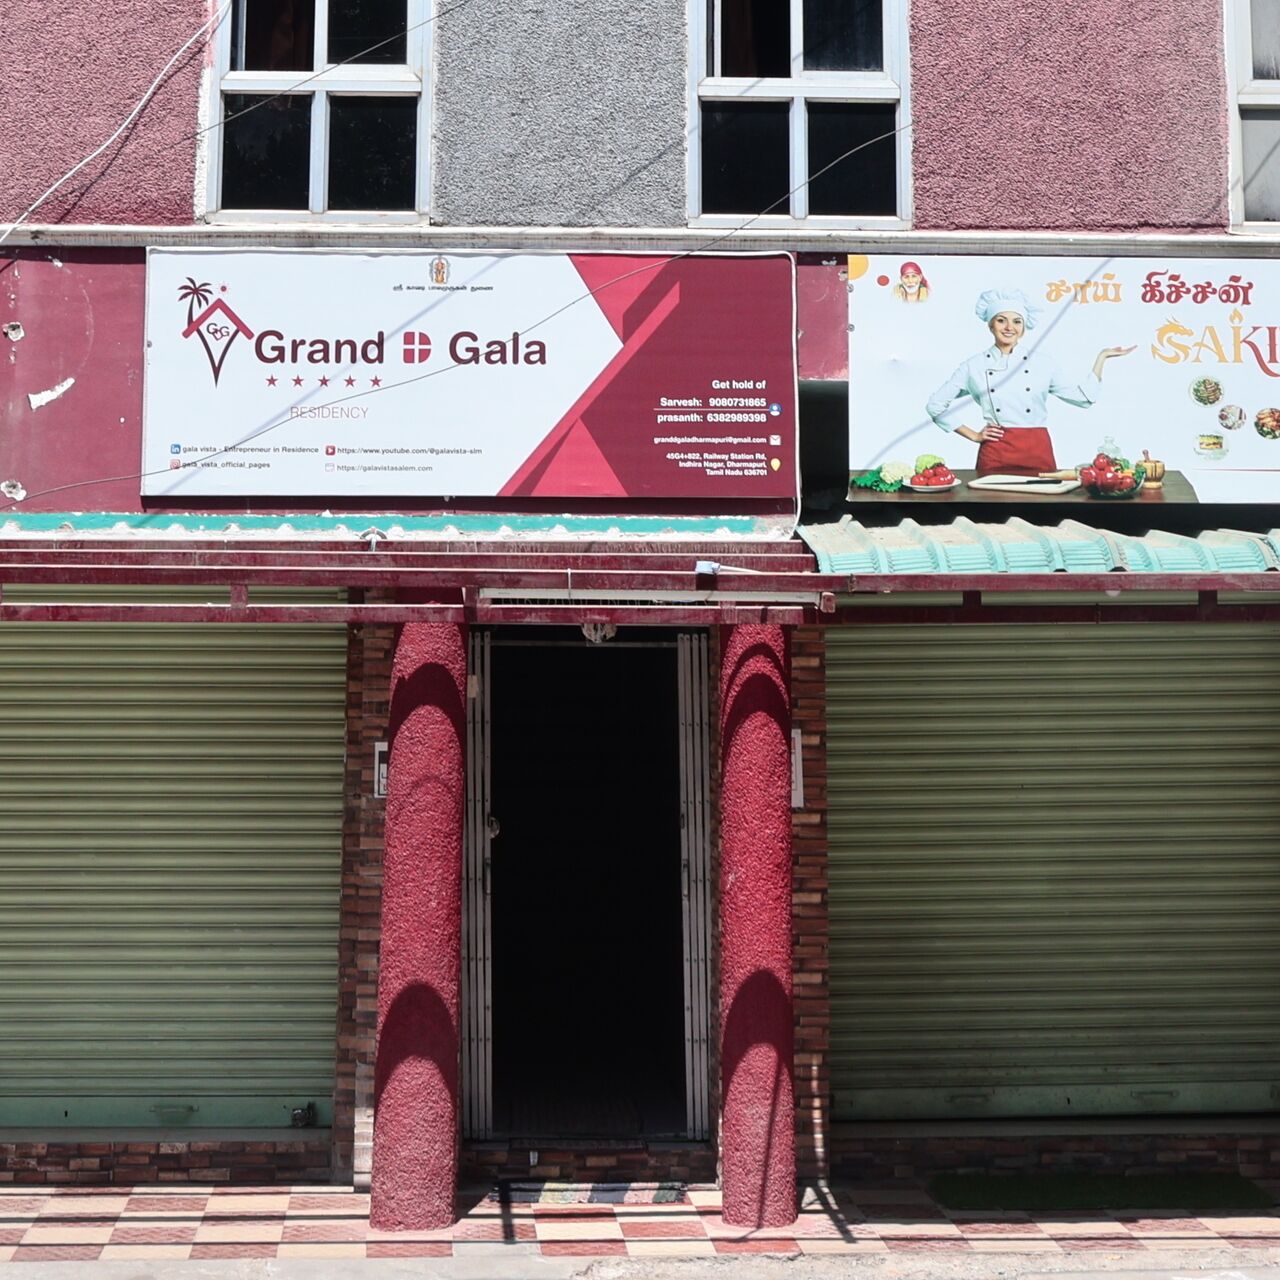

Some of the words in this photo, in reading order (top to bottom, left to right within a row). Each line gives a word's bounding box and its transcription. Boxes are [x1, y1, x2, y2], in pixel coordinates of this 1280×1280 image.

[1045, 272, 1122, 305] சாய்
[1140, 268, 1255, 306] கிச்சன்
[254, 329, 385, 365] Grand
[448, 330, 547, 366] Gala
[712, 380, 730, 389] Get
[732, 380, 753, 389] hold
[755, 380, 766, 389] of
[660, 397, 702, 407] Sarvesh:
[709, 397, 766, 407] 9080731865
[290, 406, 369, 420] RESIDENCY
[706, 412, 767, 422] 6382989398
[200, 445, 217, 453] vista
[282, 445, 319, 453] Residence
[703, 452, 729, 461] Railway
[730, 452, 754, 460] Station
